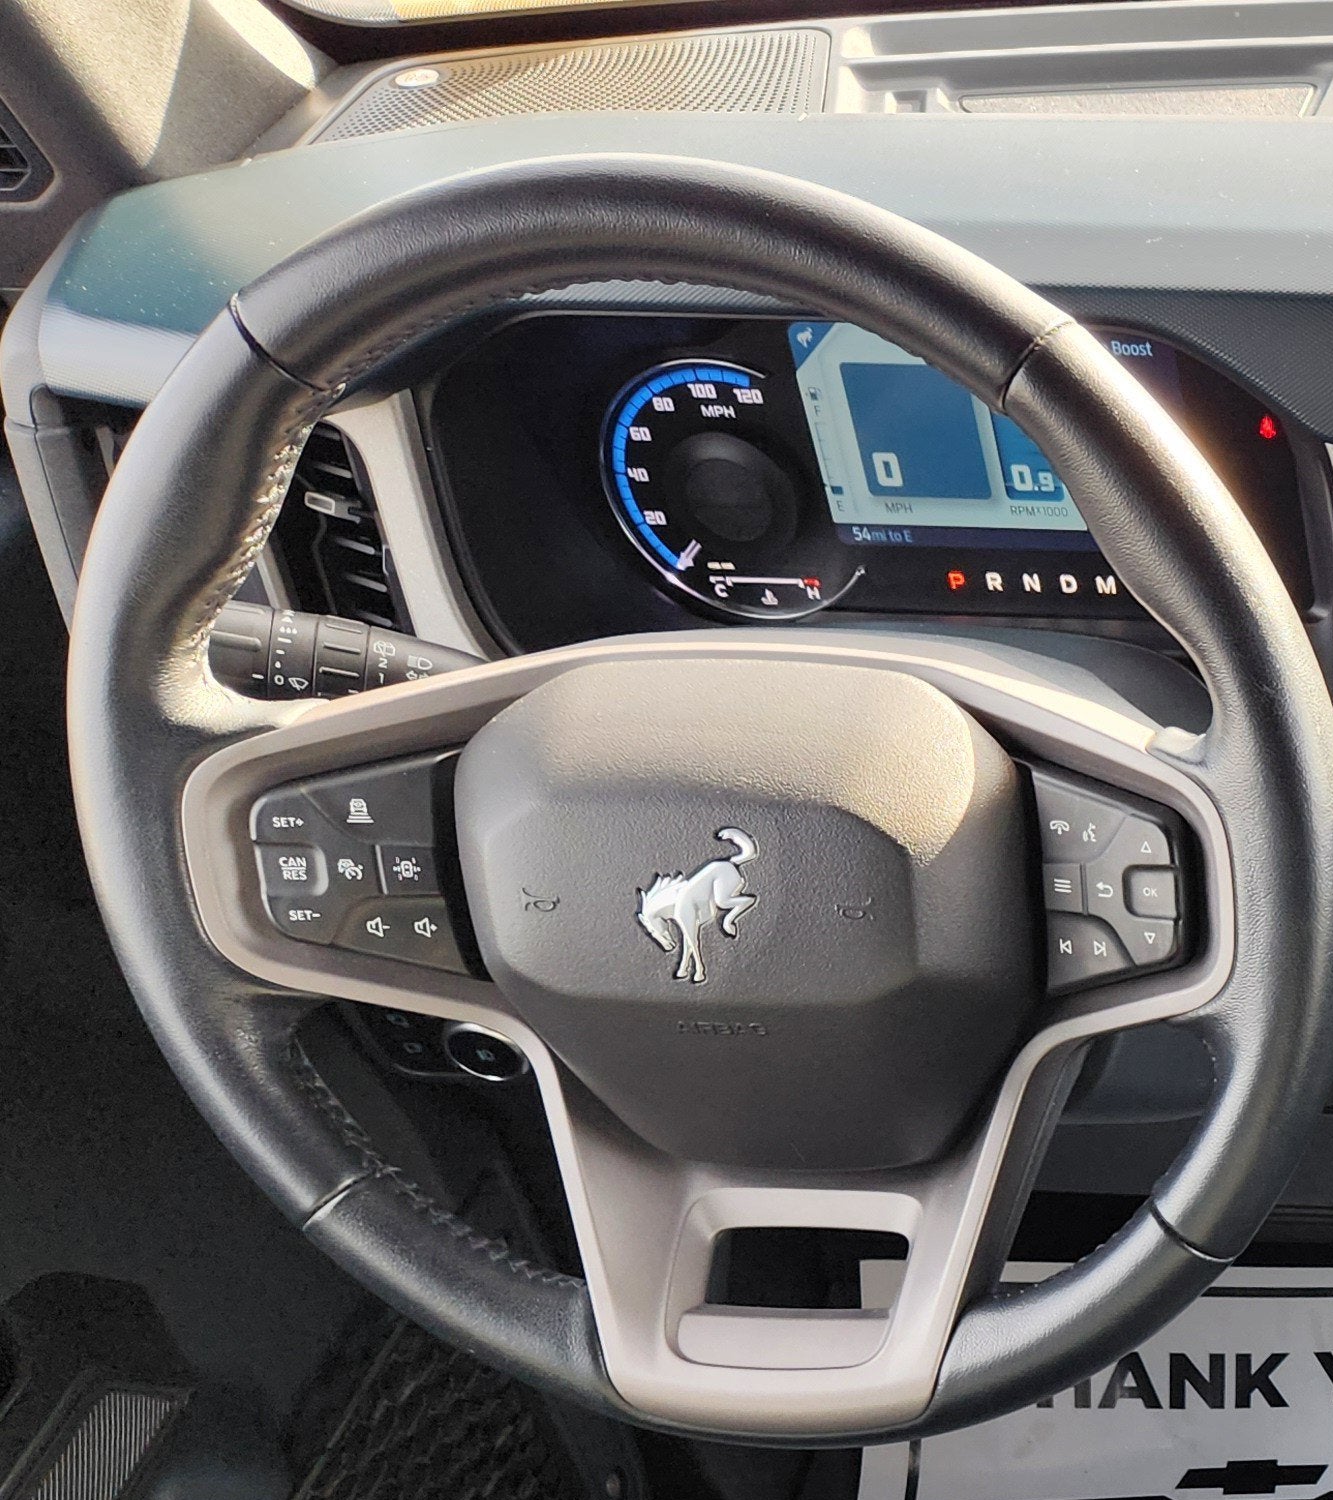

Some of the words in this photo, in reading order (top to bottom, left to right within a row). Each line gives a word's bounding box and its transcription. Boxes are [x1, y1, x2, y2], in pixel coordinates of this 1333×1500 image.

[1111, 340, 1153, 357] Boost
[687, 383, 717, 400] 100
[733, 388, 764, 404] 120
[652, 396, 675, 412] 80
[700, 404, 737, 419] MPH
[628, 426, 652, 442] 60
[627, 467, 650, 483] 40
[872, 451, 903, 488] 0
[1011, 463, 1055, 493] 0.9
[884, 502, 914, 515] MPH
[643, 510, 667, 526] 20
[947, 571, 966, 590] P
[985, 571, 1004, 592] R
[1022, 572, 1042, 593] N
[1059, 573, 1078, 594] D
[1095, 575, 1117, 595] M
[279, 856, 307, 867] CAN
[282, 869, 308, 880] RES
[1143, 886, 1158, 897] OK
[1036, 1350, 1290, 1410] ANK
